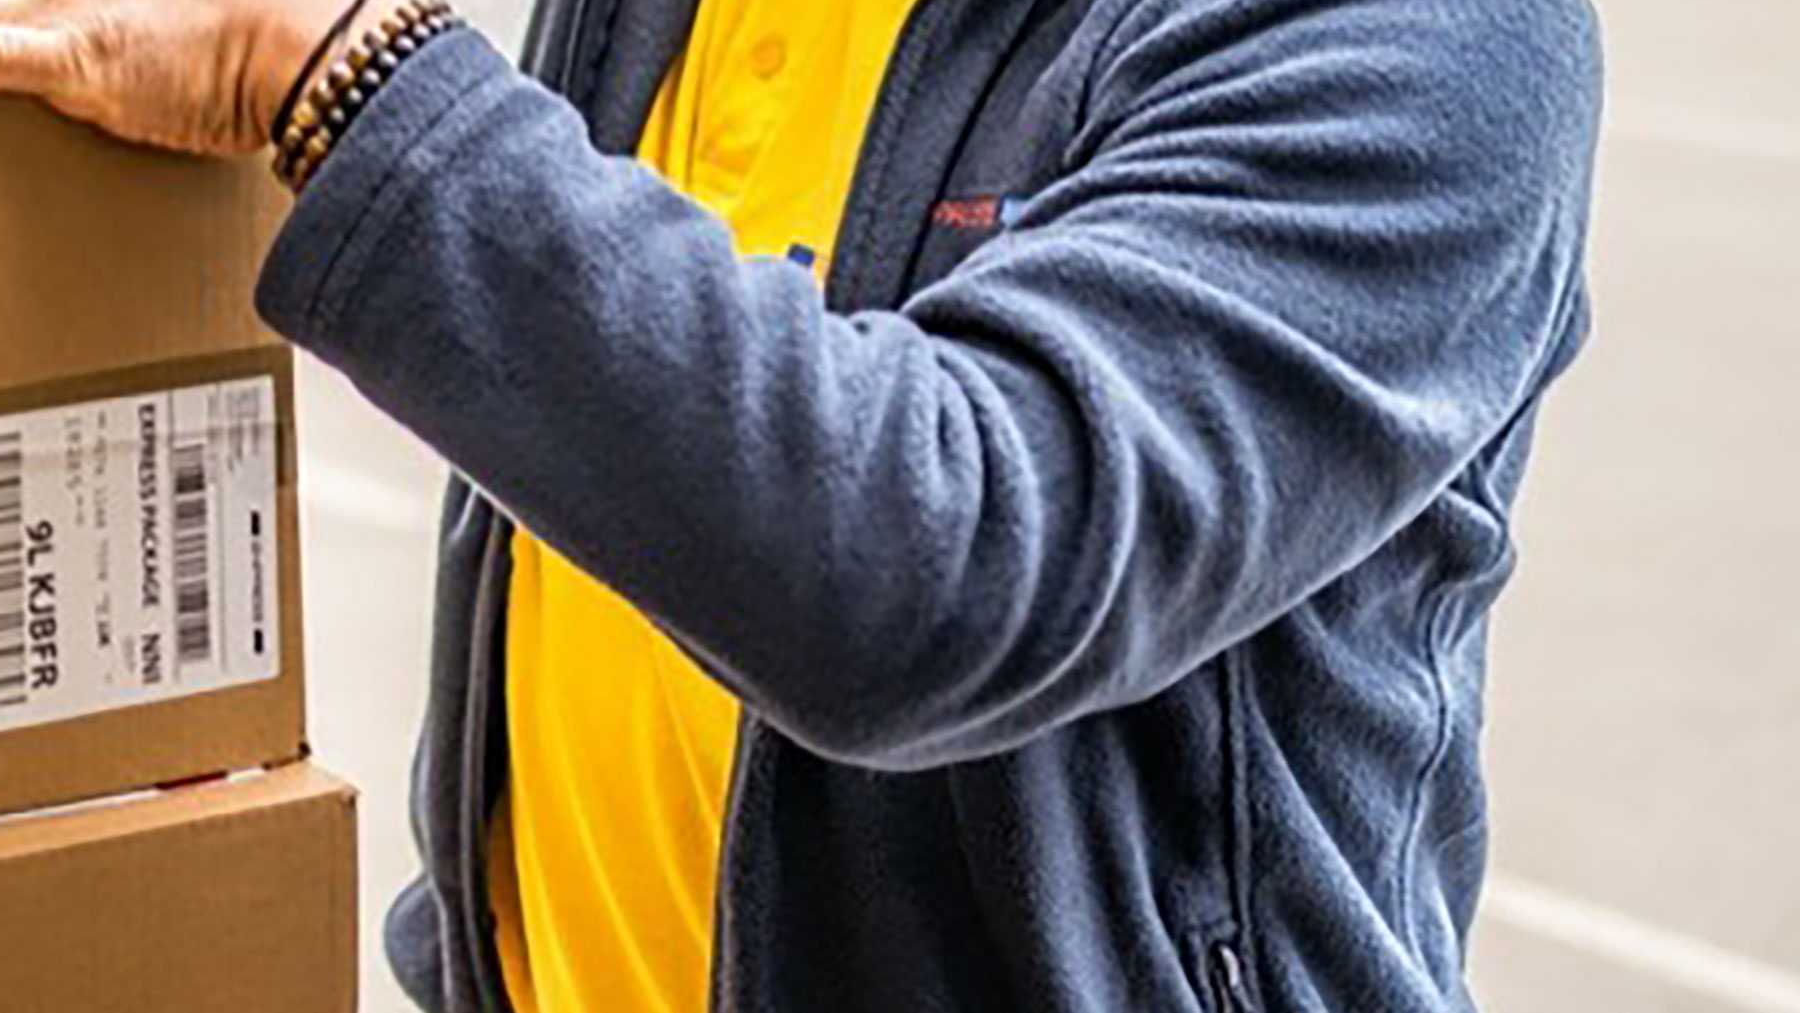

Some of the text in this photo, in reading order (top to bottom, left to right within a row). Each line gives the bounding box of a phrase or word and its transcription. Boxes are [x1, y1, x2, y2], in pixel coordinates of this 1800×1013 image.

[137, 404, 157, 501] EXPRESS
[25, 520, 59, 689] 9L KJBFR
[140, 503, 161, 608] PACKAGE
